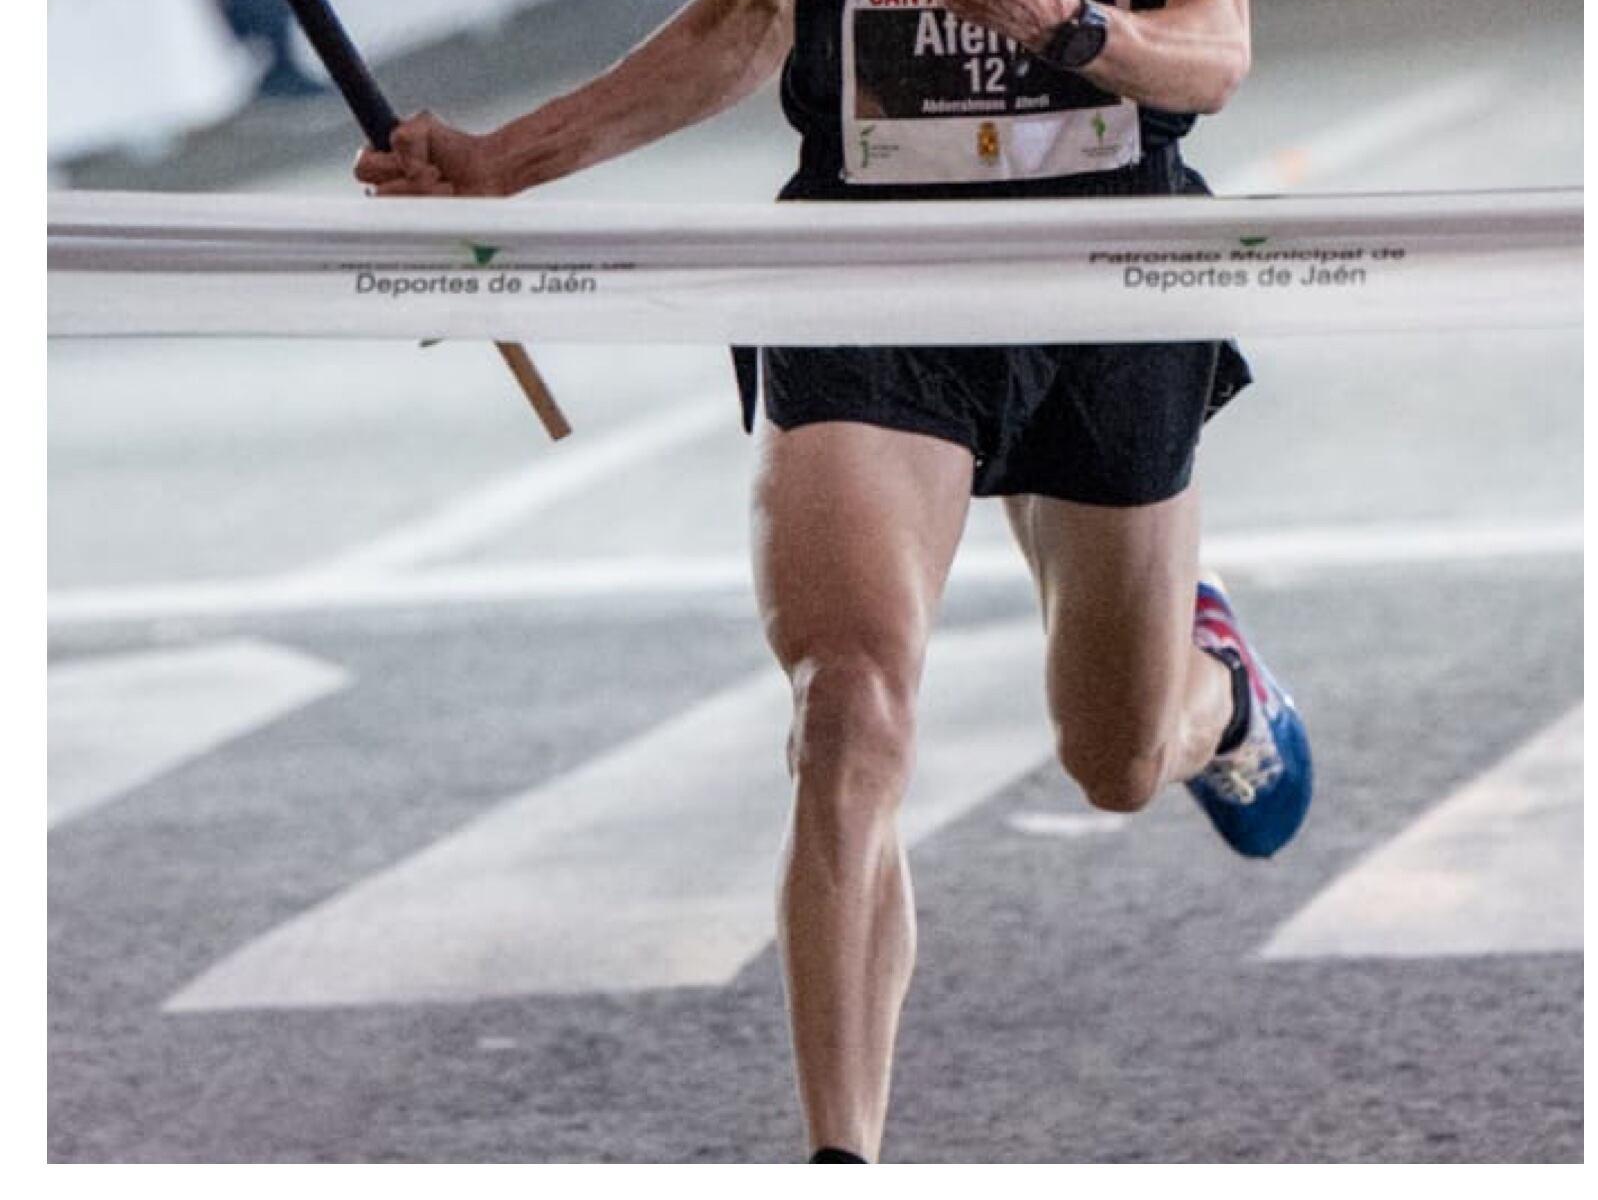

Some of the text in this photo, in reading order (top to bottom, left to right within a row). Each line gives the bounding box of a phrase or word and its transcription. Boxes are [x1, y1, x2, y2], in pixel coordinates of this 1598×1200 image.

[963, 57, 1007, 93] 12
[356, 272, 597, 297] Deportes de Jaén
[1123, 264, 1367, 291] Deportes de Jaén
